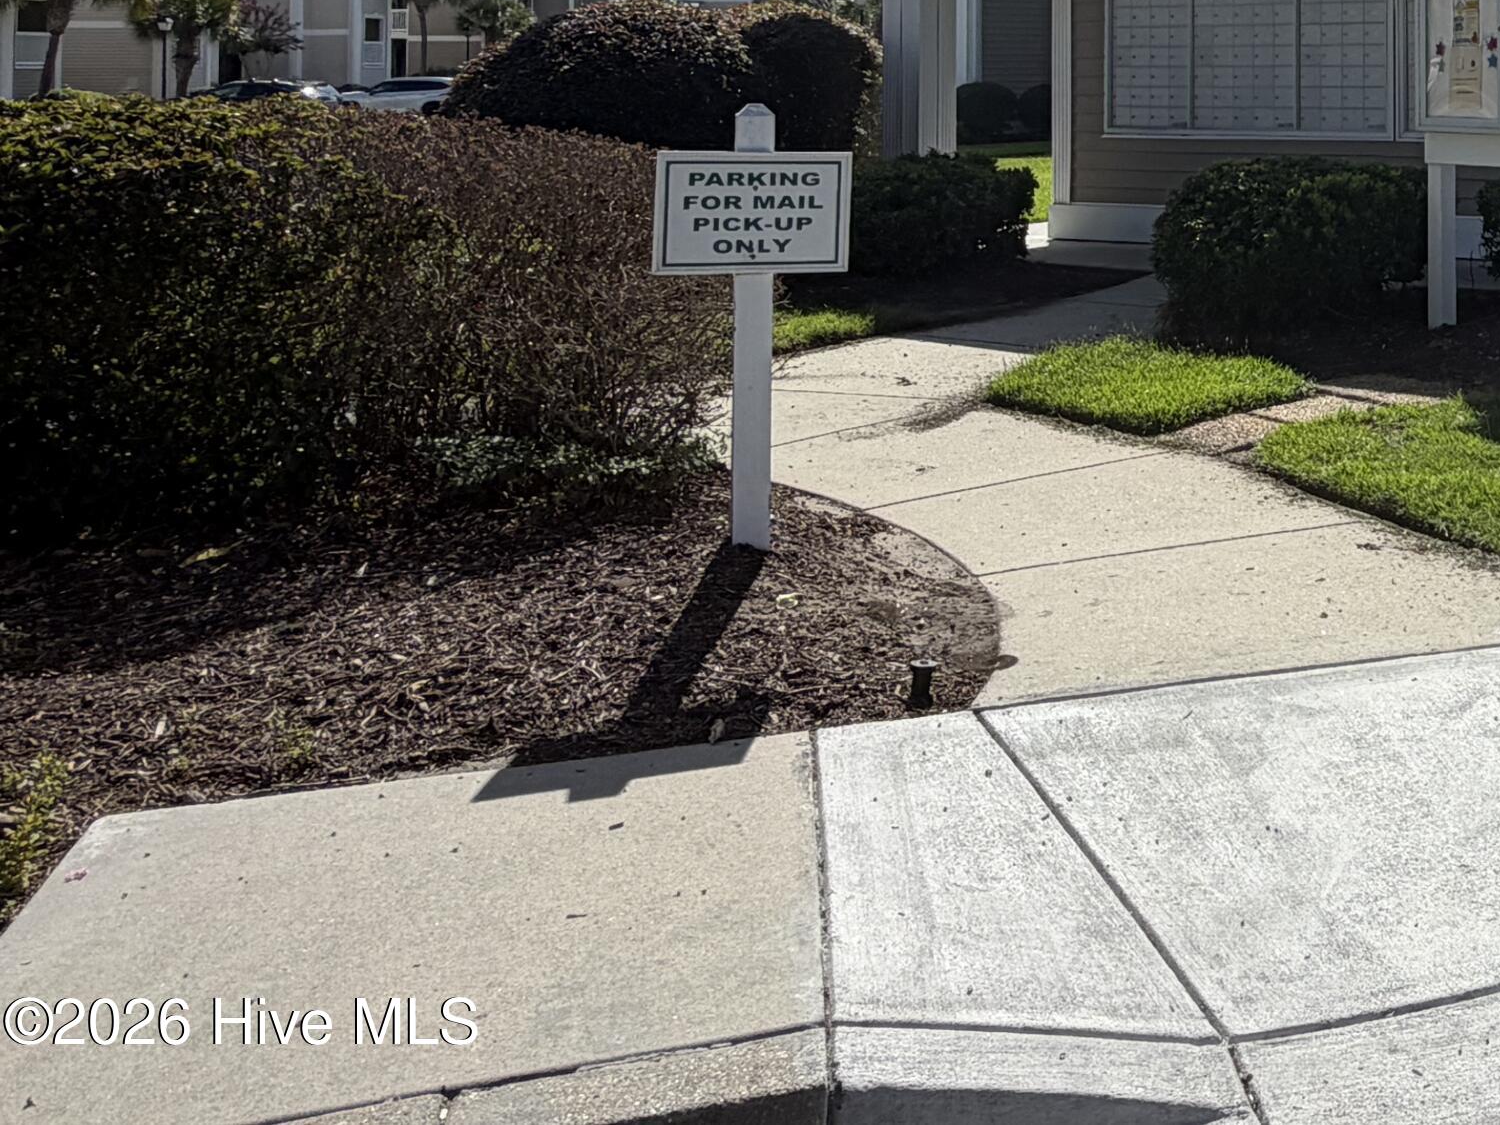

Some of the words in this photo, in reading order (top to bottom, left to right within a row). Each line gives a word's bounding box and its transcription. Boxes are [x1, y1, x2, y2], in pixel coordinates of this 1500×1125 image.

[688, 171, 820, 187] PARKING
[683, 195, 742, 210] FOR
[753, 195, 823, 210] MAIL
[693, 217, 813, 232] PICK-UP
[713, 238, 792, 254] ONLY
